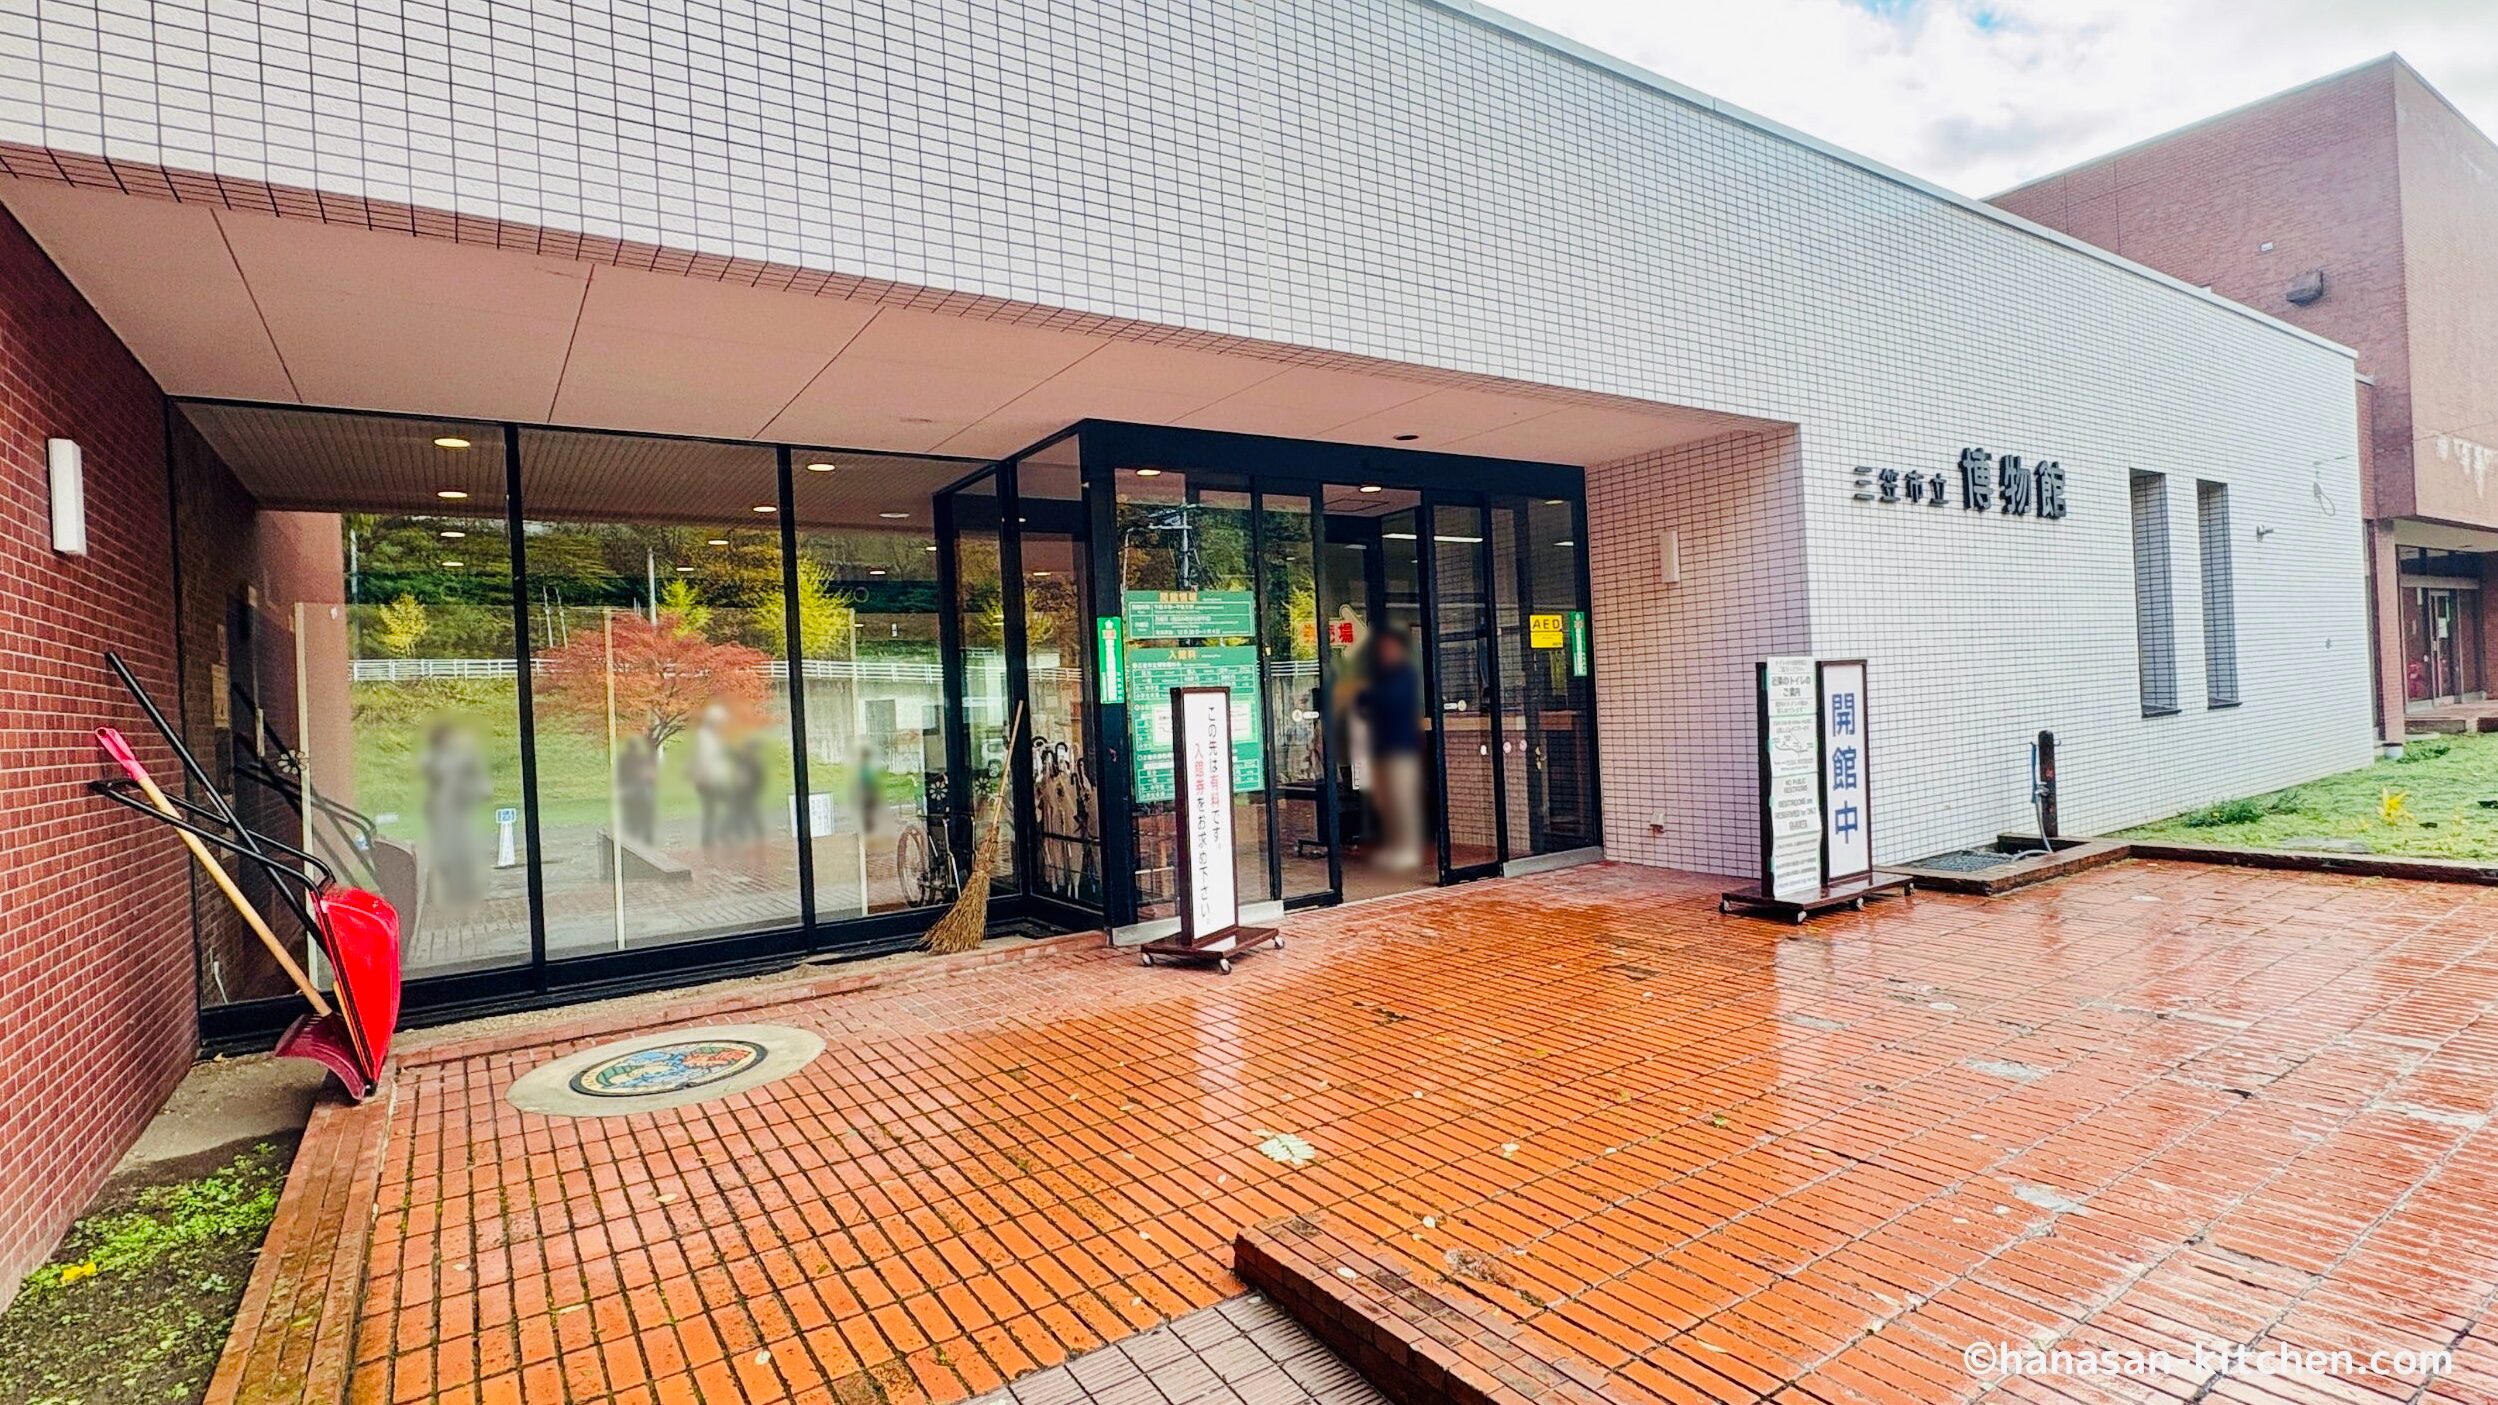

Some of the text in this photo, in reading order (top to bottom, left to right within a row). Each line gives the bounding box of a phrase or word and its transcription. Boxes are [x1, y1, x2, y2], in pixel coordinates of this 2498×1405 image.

[1854, 448, 2067, 519] 三笠市立 博物館
[1533, 619, 1560, 629] AED
[1194, 743, 1211, 925] 入館券をお求め下さい。
[1208, 706, 1222, 850] この先は有料です。
[1831, 692, 1859, 844] 開館中
